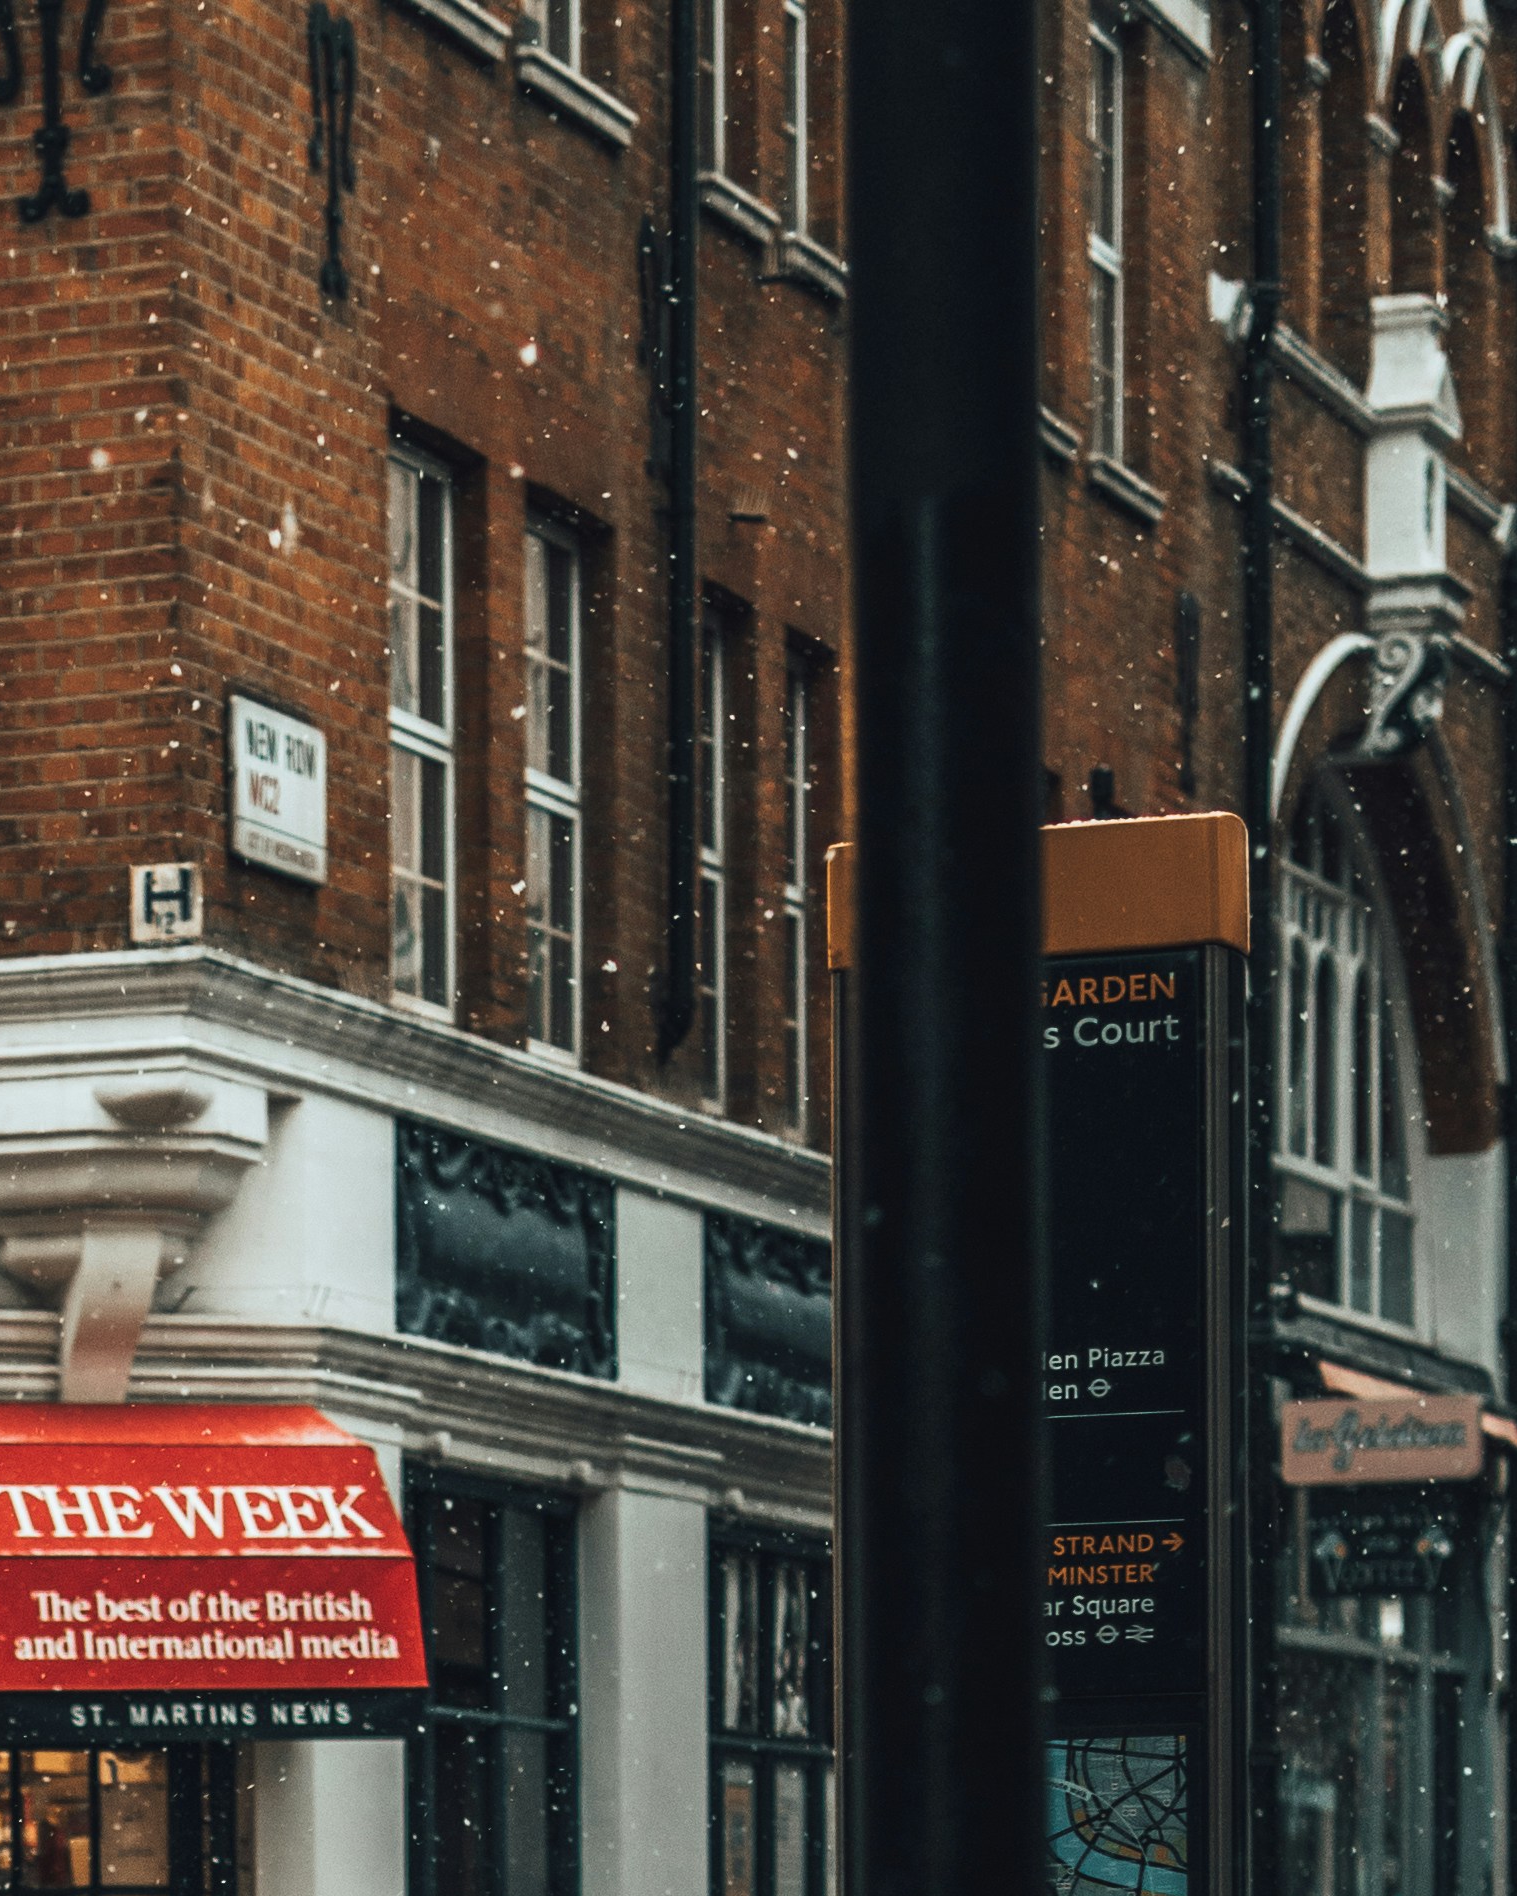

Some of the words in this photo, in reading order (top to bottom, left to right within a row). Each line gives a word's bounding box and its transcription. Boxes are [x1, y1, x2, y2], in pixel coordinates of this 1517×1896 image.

[245, 719, 278, 764] NEW
[285, 734, 316, 780] ROW
[248, 771, 280, 815] WC2
[144, 868, 192, 923] H
[1073, 1015, 1179, 1047] Court
[1041, 1351, 1078, 1370] en
[1088, 1348, 1165, 1369] Piazza
[1041, 1381, 1079, 1400] en
[150, 1485, 384, 1539] WEEK
[1053, 1534, 1154, 1556] STRAND
[1047, 1564, 1154, 1586] MINSTER
[31, 1590, 90, 1622] The
[96, 1590, 162, 1622] best
[169, 1590, 203, 1622] of
[207, 1590, 260, 1622] the
[266, 1590, 372, 1622] British
[1072, 1595, 1155, 1619] Square
[14, 1629, 77, 1661] and
[82, 1629, 295, 1661] International
[301, 1630, 399, 1660] media
[1045, 1630, 1086, 1646] oss
[130, 1704, 257, 1726] MARTINS
[272, 1704, 352, 1725] NEWS
